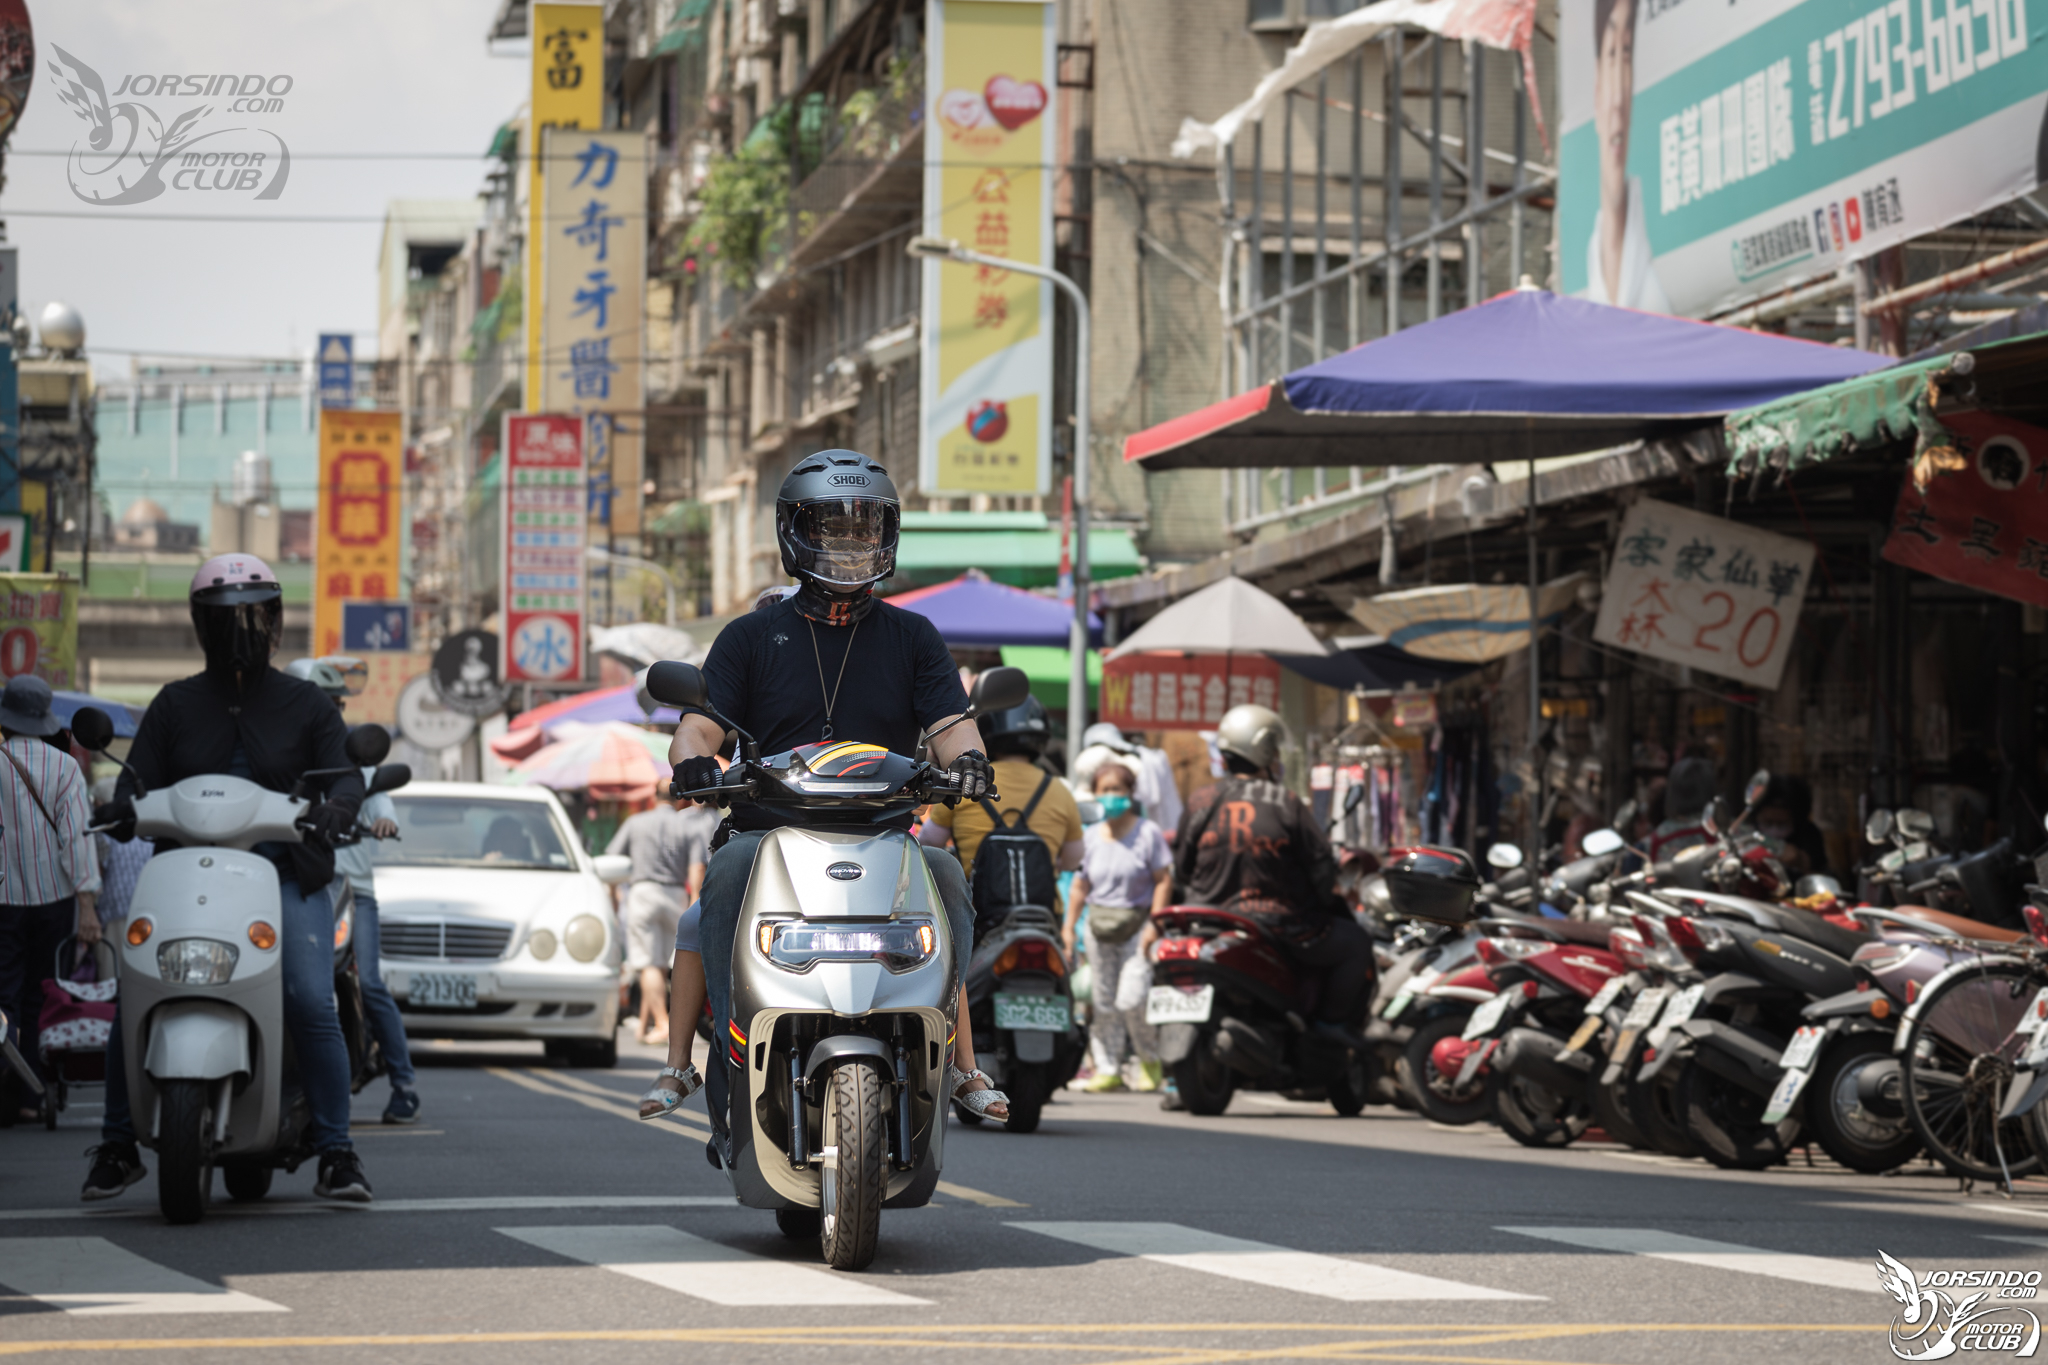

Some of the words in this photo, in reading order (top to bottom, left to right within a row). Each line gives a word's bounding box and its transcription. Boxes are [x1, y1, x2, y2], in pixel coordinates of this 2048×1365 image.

[833, 475, 866, 485] SHOEI
[517, 625, 571, 674] 冰
[1693, 590, 1781, 668] 20
